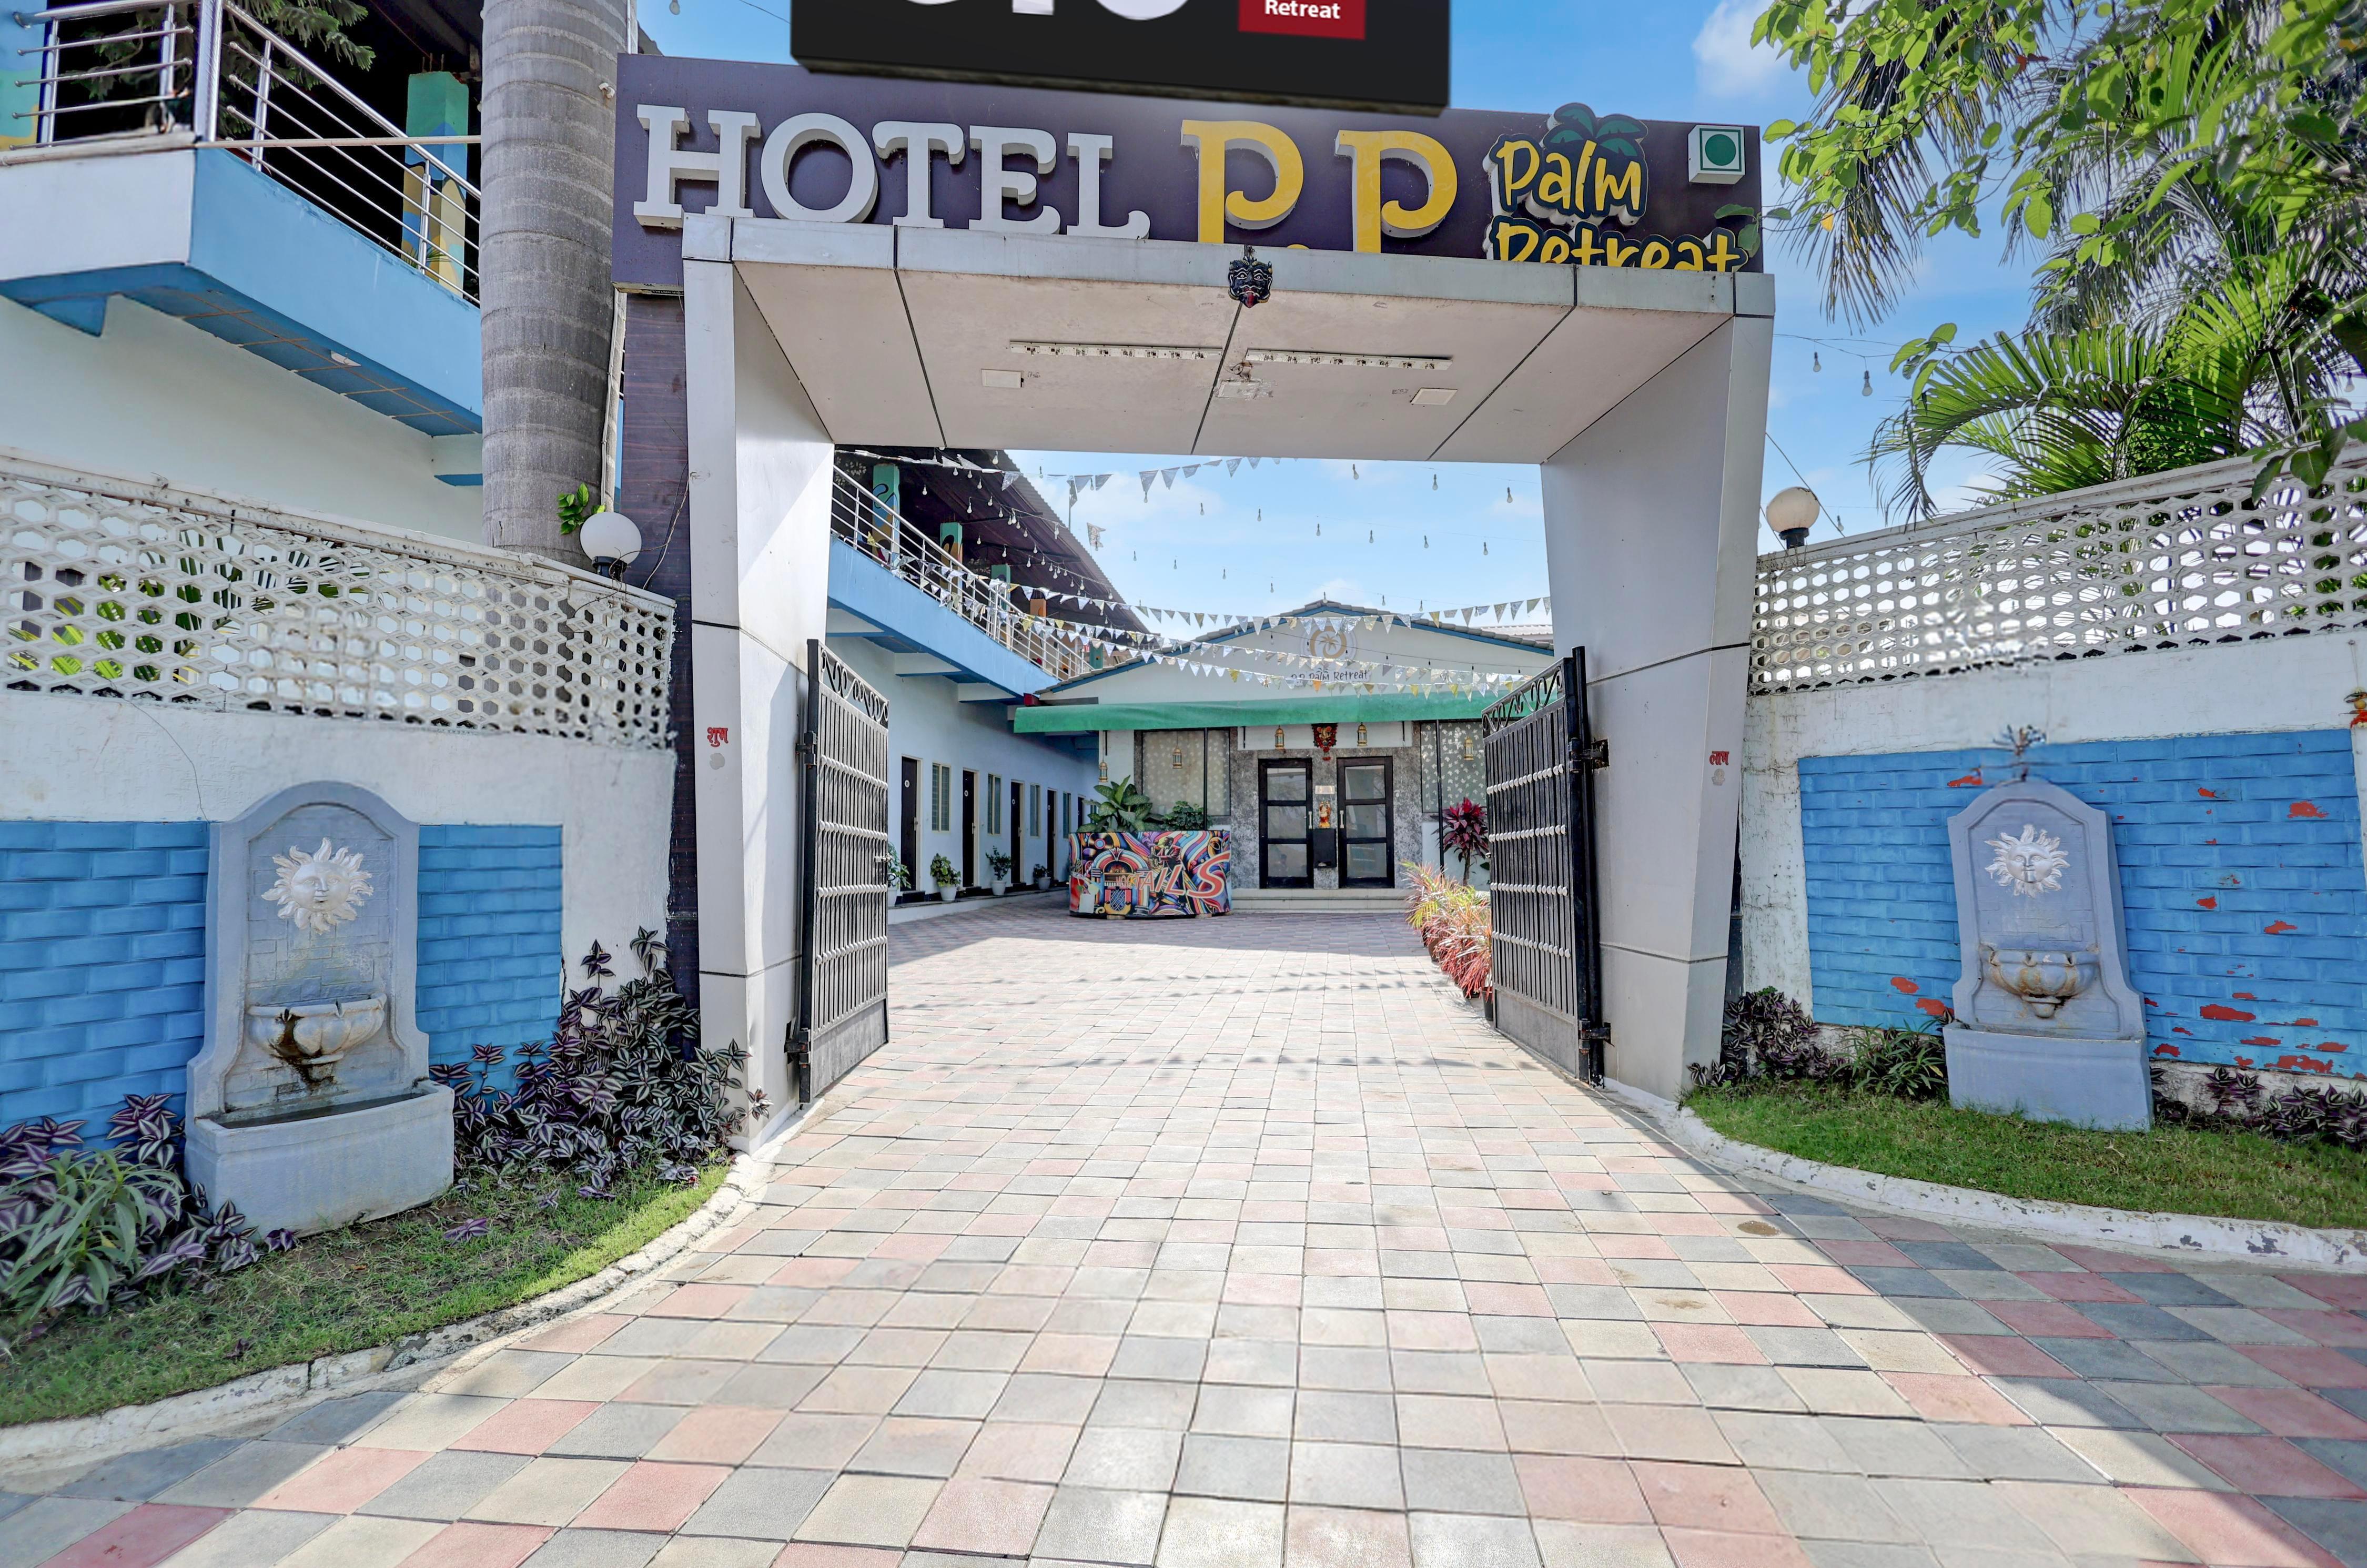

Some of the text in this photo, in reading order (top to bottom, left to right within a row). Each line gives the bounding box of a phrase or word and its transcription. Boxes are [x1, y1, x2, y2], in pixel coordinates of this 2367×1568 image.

[1265, 0, 1341, 19] Retreat
[633, 104, 1151, 240] HOTEL
[1495, 139, 1642, 213] Palm
[1333, 670, 1368, 681] Retreat
[706, 726, 729, 748] शुभ
[1709, 750, 1730, 766] लाभ
